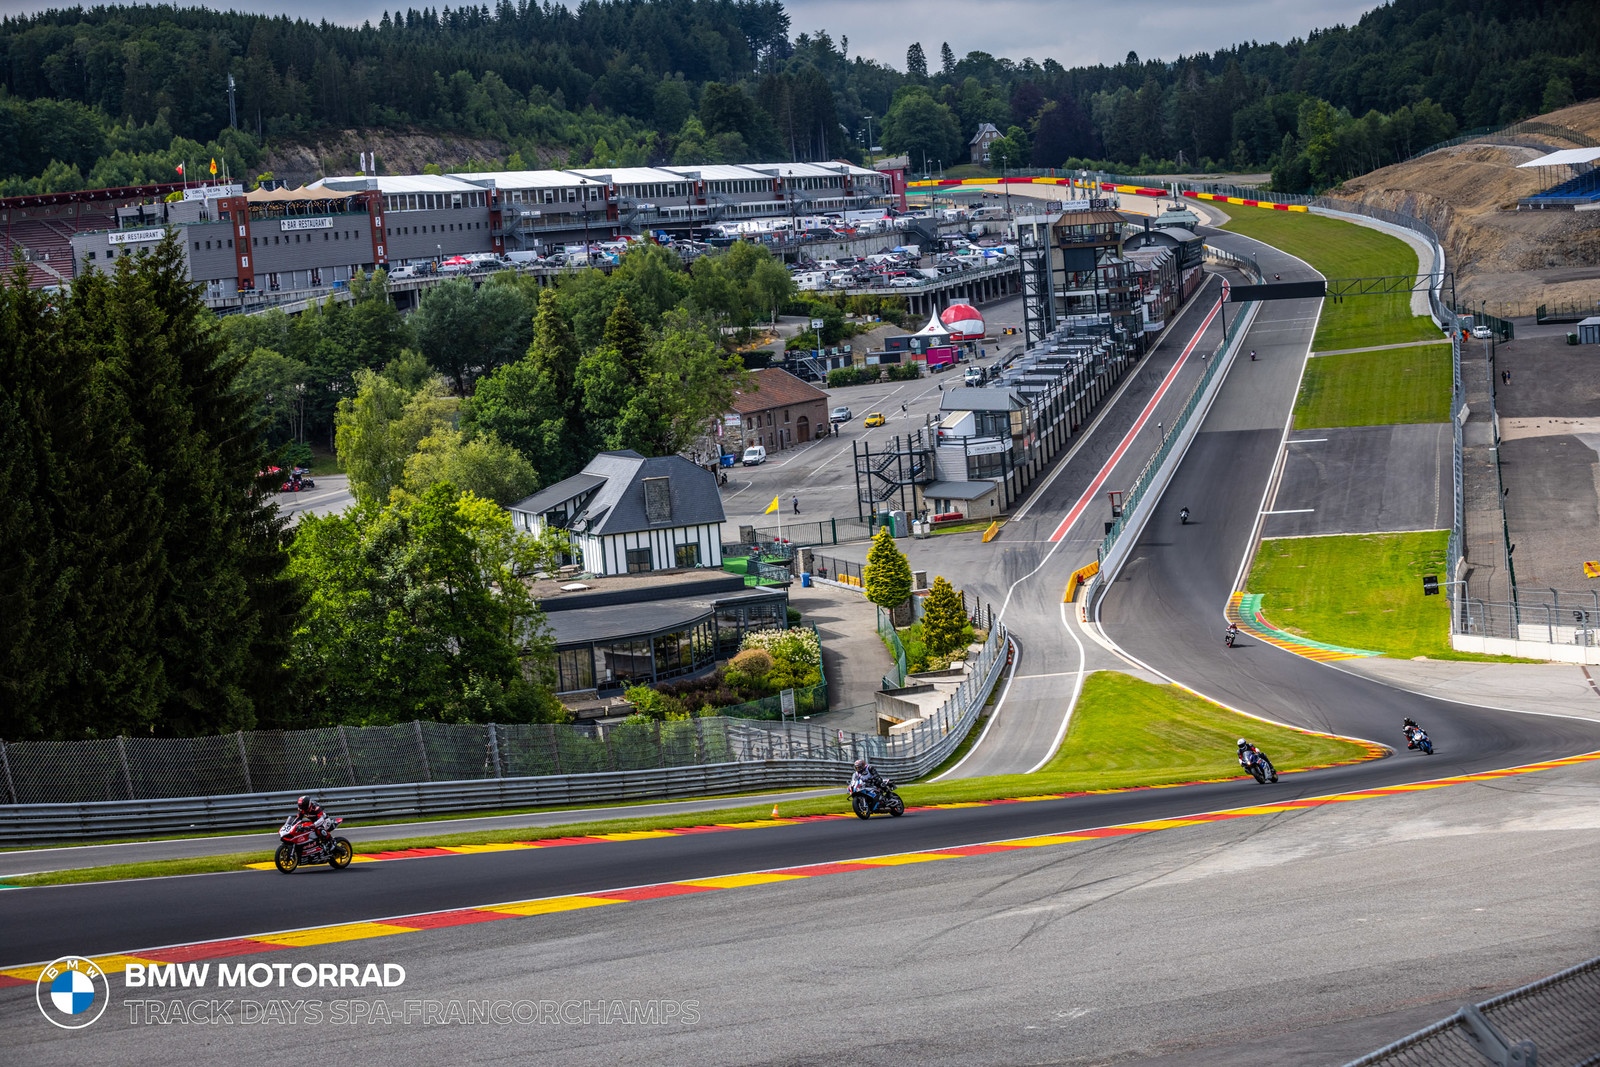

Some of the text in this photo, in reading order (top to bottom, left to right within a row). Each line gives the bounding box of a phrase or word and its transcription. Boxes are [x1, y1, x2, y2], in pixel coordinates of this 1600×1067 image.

[287, 218, 327, 229] BAR RESTAURANT
[127, 231, 159, 240] RESTAURANT
